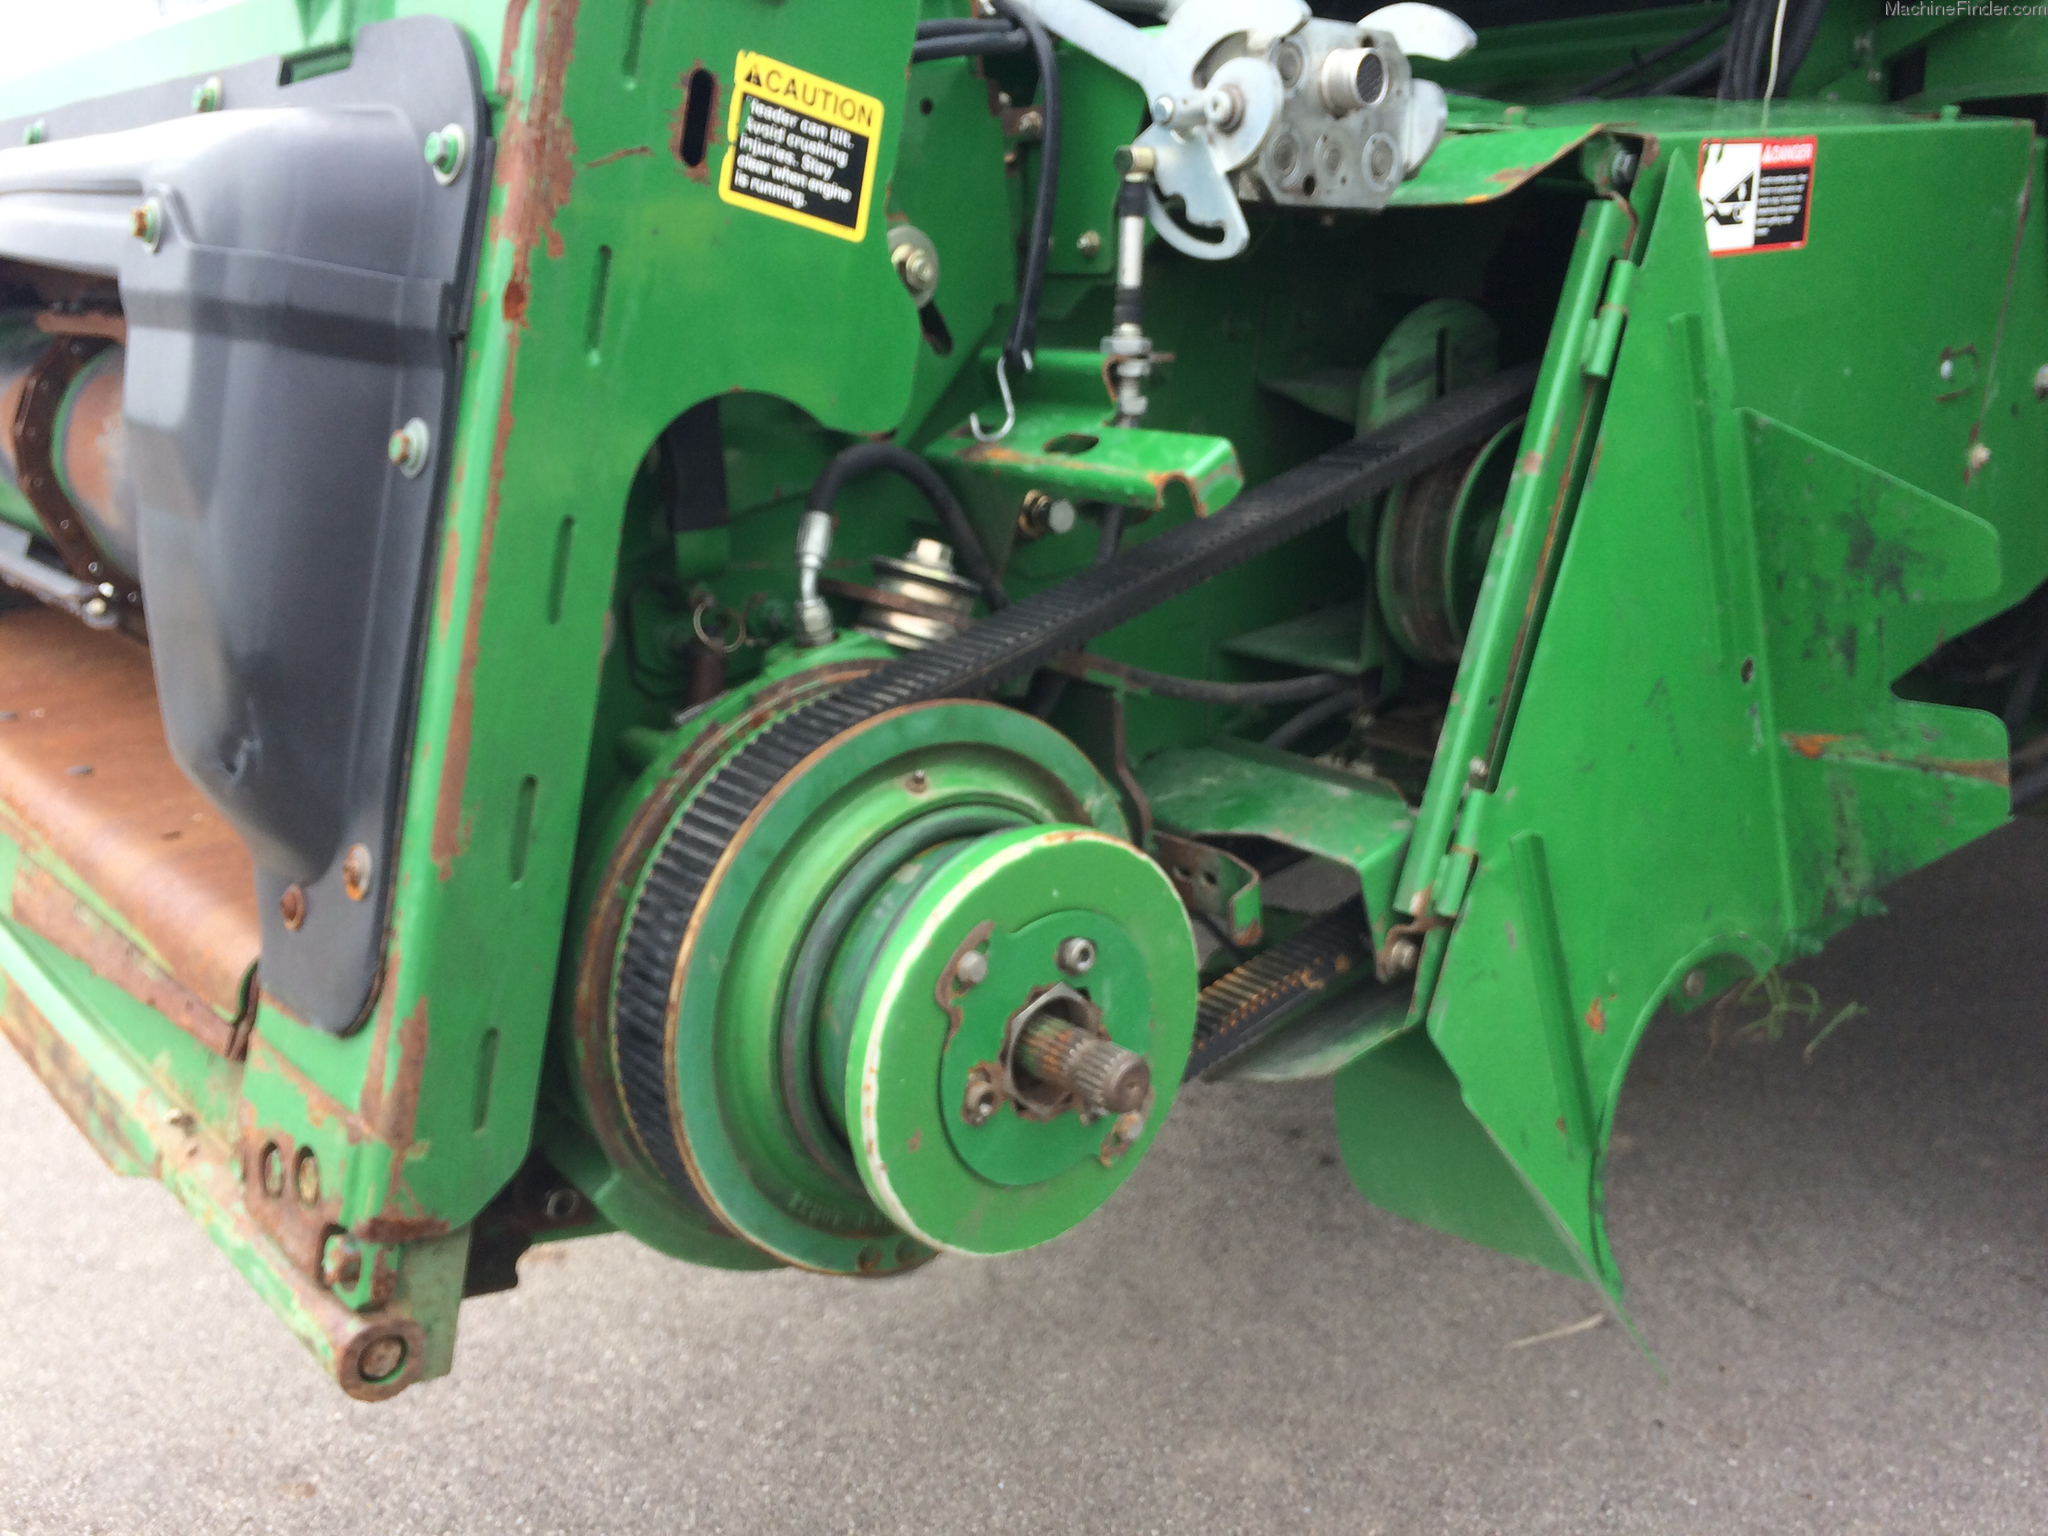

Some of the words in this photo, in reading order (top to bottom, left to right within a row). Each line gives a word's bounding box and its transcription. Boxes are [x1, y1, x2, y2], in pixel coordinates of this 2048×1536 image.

[765, 70, 873, 127] CAUTION
[786, 132, 849, 169] crushing
[800, 118, 828, 140] can
[829, 126, 854, 149] tilt.
[736, 153, 771, 175] clear
[771, 164, 808, 189] when
[808, 177, 852, 203] engine
[800, 153, 835, 181] Stay
[734, 169, 750, 188] is
[750, 176, 807, 208] running.
